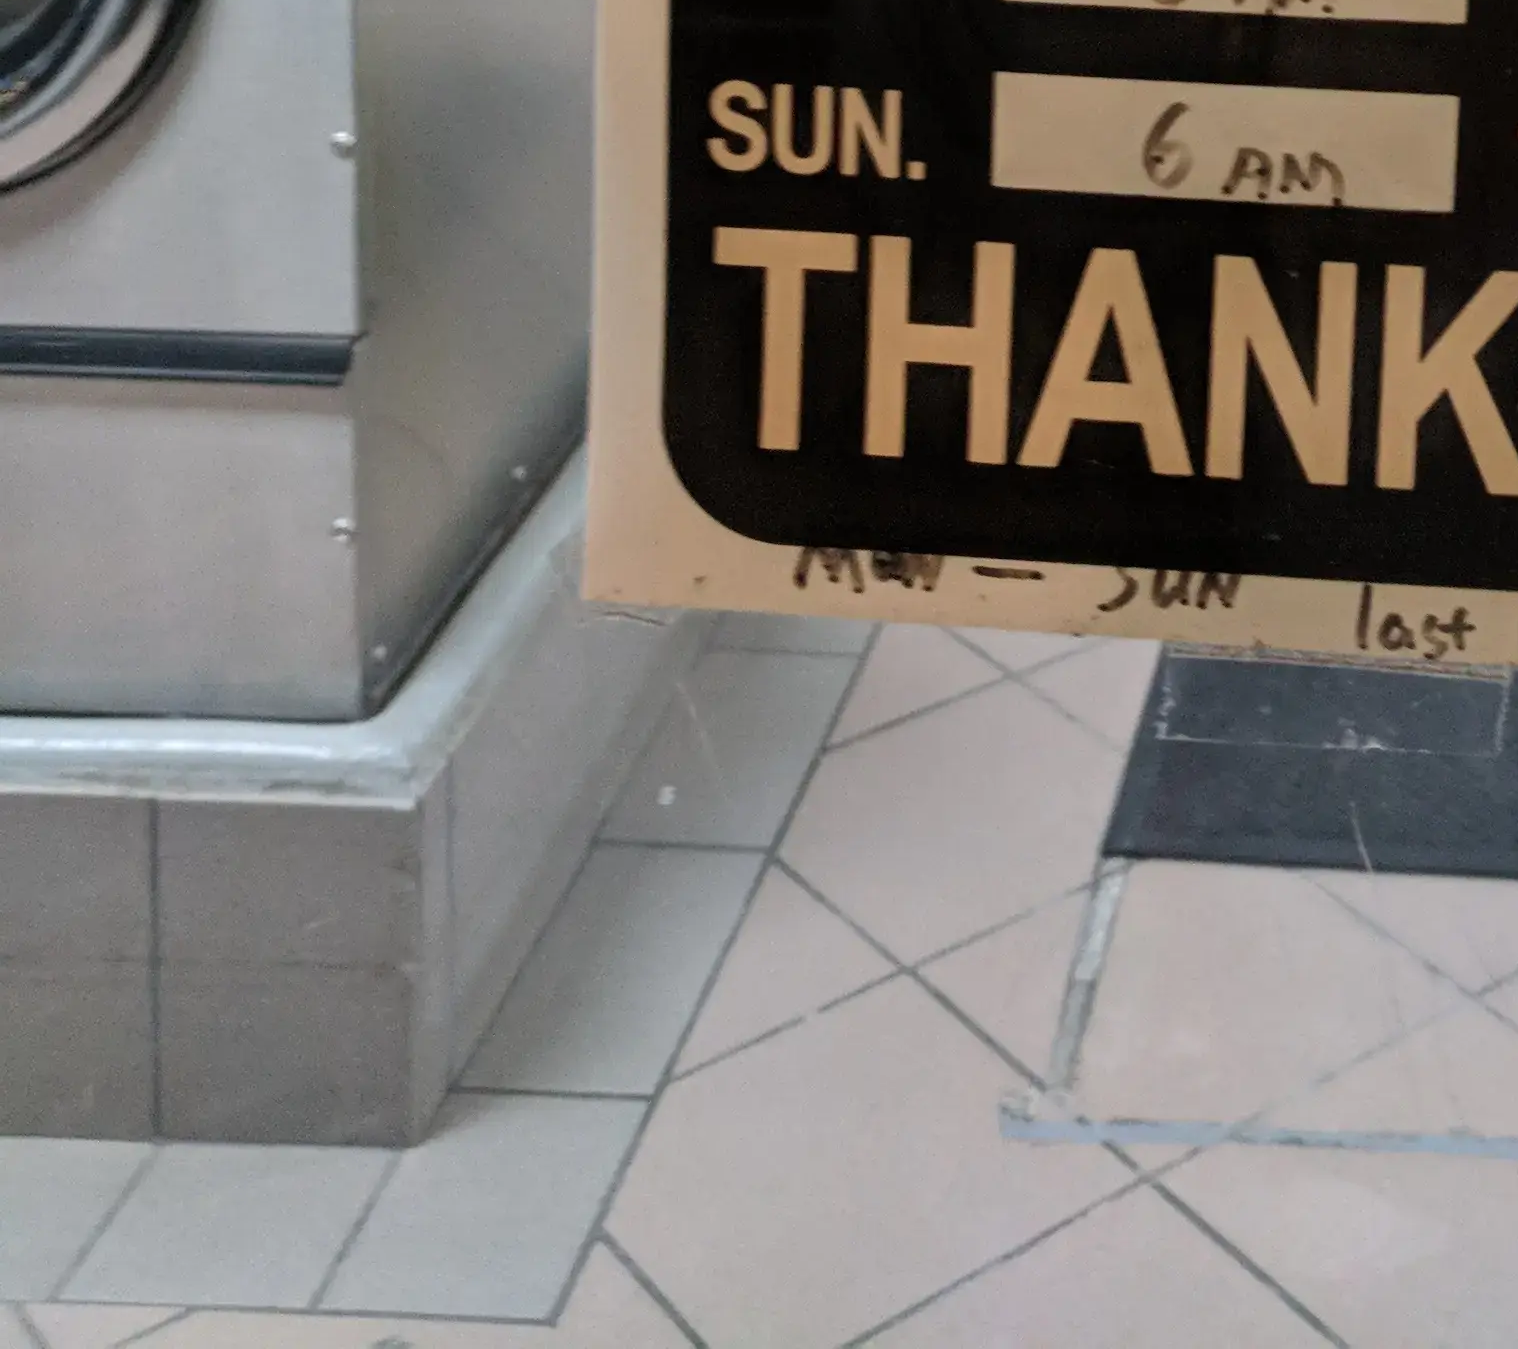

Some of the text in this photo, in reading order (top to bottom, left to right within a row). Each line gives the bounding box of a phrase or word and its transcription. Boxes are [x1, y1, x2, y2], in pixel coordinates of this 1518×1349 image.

[709, 81, 924, 179] SUN.
[1142, 102, 1192, 188] 6
[1222, 148, 1346, 205] AM
[1354, 585, 1477, 663] last
